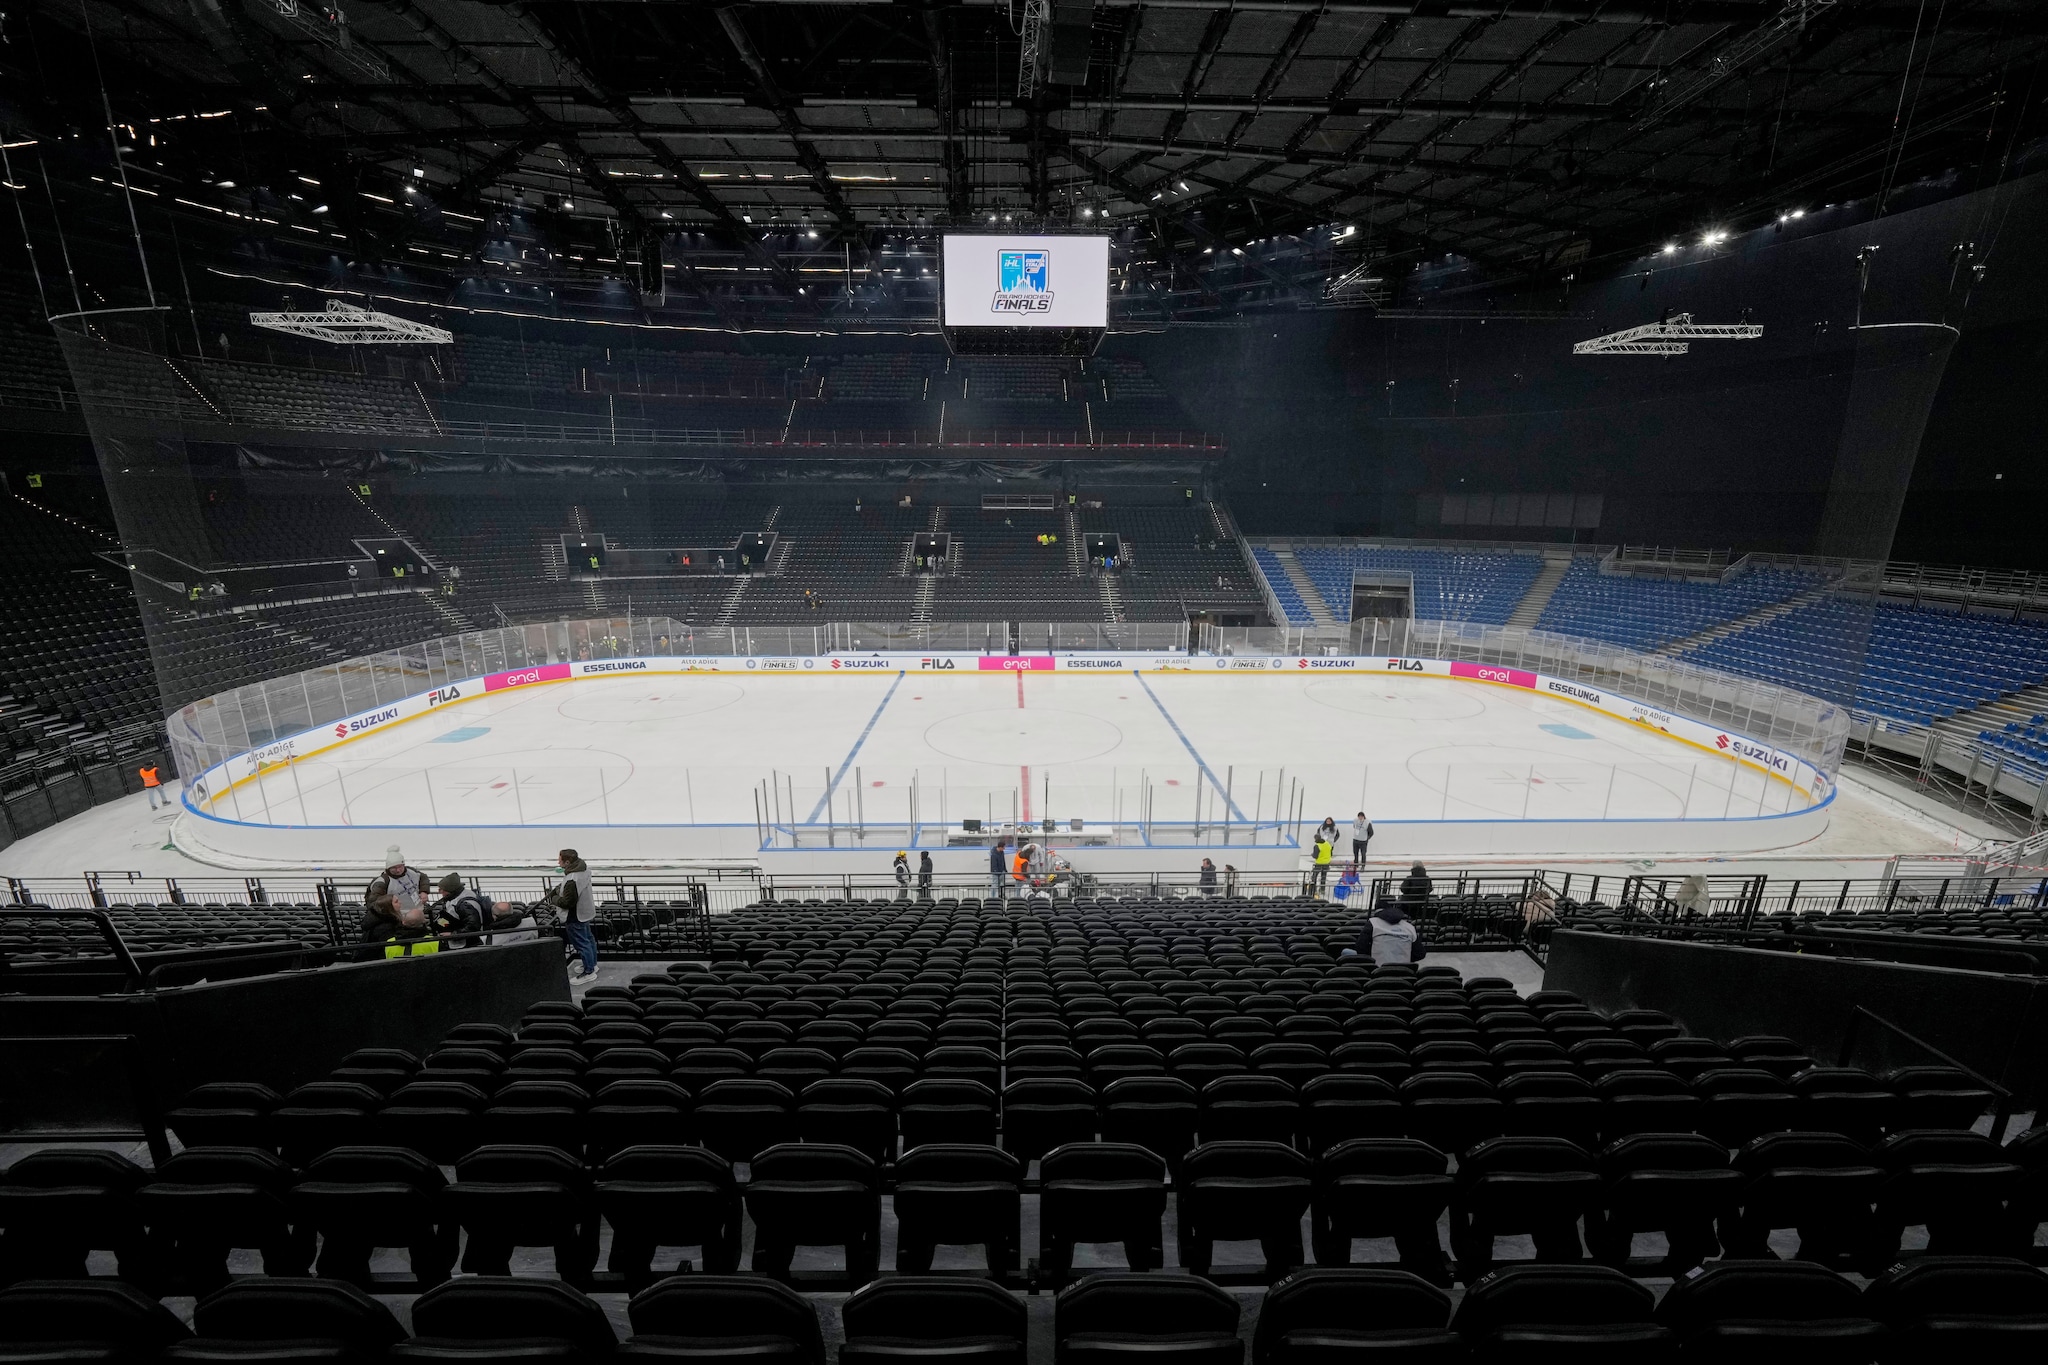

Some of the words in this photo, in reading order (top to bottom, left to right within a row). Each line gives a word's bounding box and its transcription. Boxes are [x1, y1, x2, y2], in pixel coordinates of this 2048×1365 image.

[995, 299, 1049, 310] FINALS
[583, 661, 647, 673] ESSELUNGA
[844, 660, 889, 668] SUZUKI
[921, 658, 955, 669] FILA
[1003, 658, 1032, 670] enel
[1067, 660, 1123, 668] ESSELUNGA
[1310, 660, 1355, 668] SUZUKI
[1387, 658, 1424, 671] FILA
[507, 669, 540, 686] enel
[1478, 668, 1510, 683] enel
[428, 686, 461, 707] FILA
[1548, 681, 1600, 705] ESSELUNGA
[350, 707, 398, 732] SUZUKI
[1732, 741, 1788, 772] SUZUKI
